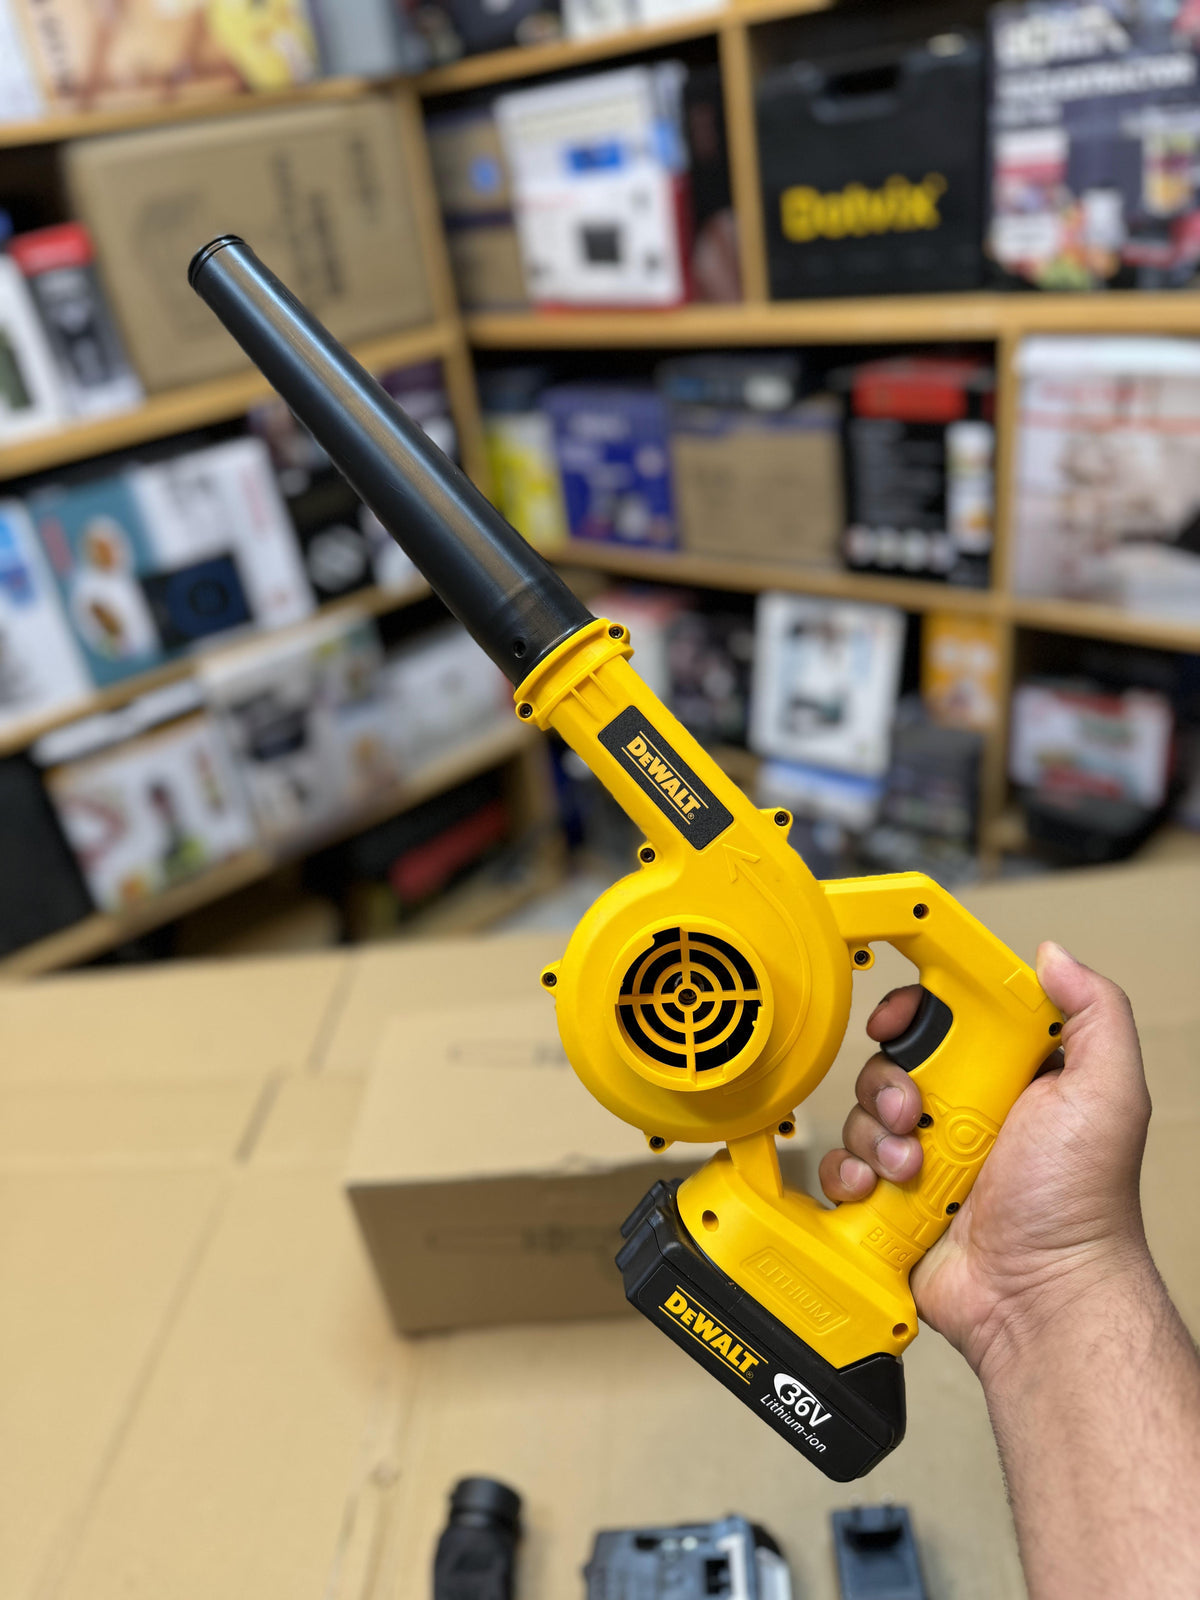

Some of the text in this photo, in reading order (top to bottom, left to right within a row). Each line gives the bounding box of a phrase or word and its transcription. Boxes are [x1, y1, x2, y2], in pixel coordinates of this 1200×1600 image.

[867, 1226, 912, 1263] Bird
[757, 1258, 833, 1323] LITHIUM
[760, 1393, 827, 1453] Lithium-ion
[780, 1382, 832, 1428] 36V
